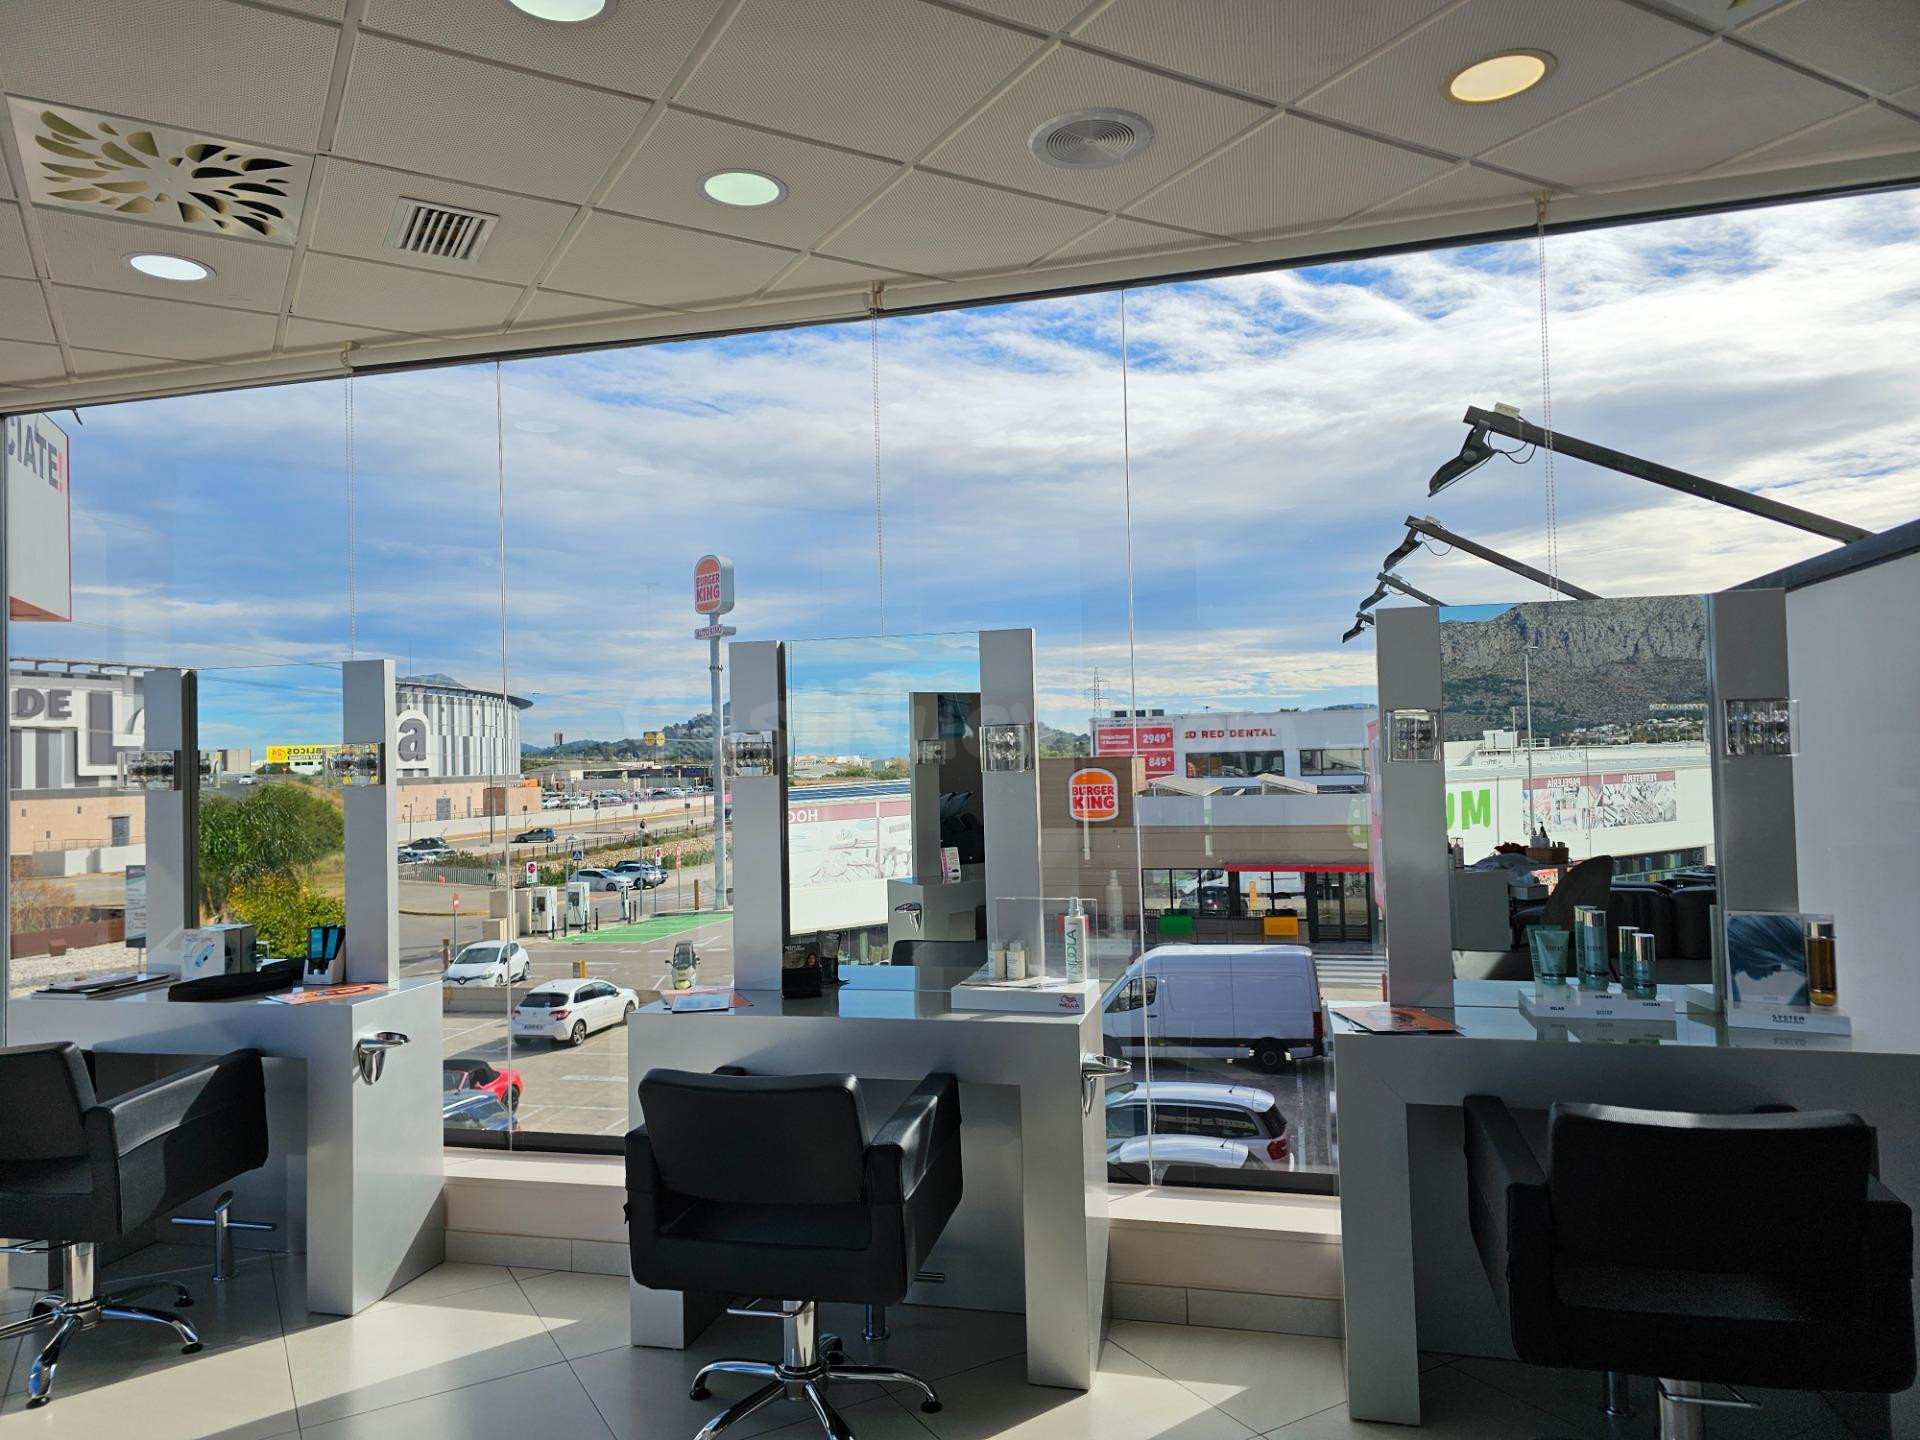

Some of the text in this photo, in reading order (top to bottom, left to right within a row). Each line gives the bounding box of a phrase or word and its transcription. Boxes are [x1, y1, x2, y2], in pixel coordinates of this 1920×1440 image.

[696, 572, 720, 588] BURGER
[696, 584, 721, 603] KING
[17, 688, 72, 718] DE
[1201, 729, 1225, 739] RED
[1229, 728, 1277, 738] DENTAL
[1072, 785, 1115, 796] BURGER
[1072, 796, 1116, 810] KING
[1058, 1001, 1080, 1009] WELLA
